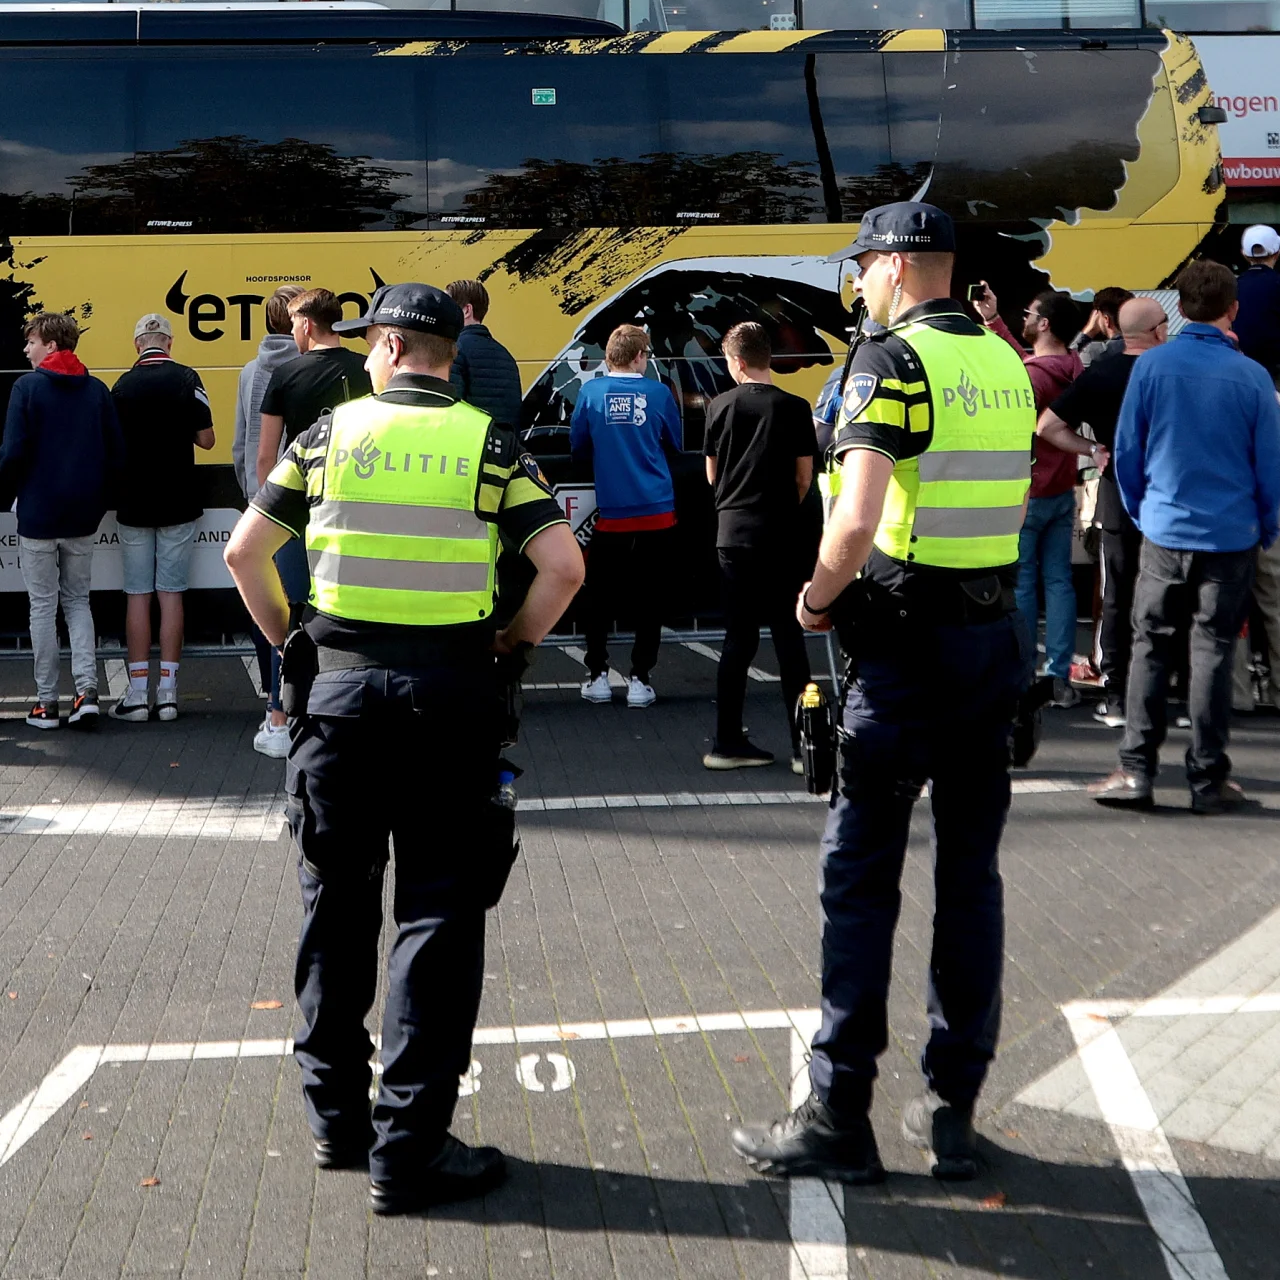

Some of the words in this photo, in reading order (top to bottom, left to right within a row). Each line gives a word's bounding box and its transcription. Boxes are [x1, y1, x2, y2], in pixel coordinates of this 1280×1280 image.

[246, 275, 312, 283] HOOFDSPONSOR
[942, 368, 1033, 418] POLITIE
[609, 403, 631, 412] ANTS
[334, 431, 470, 480] POLITIE
[565, 497, 579, 521] F
